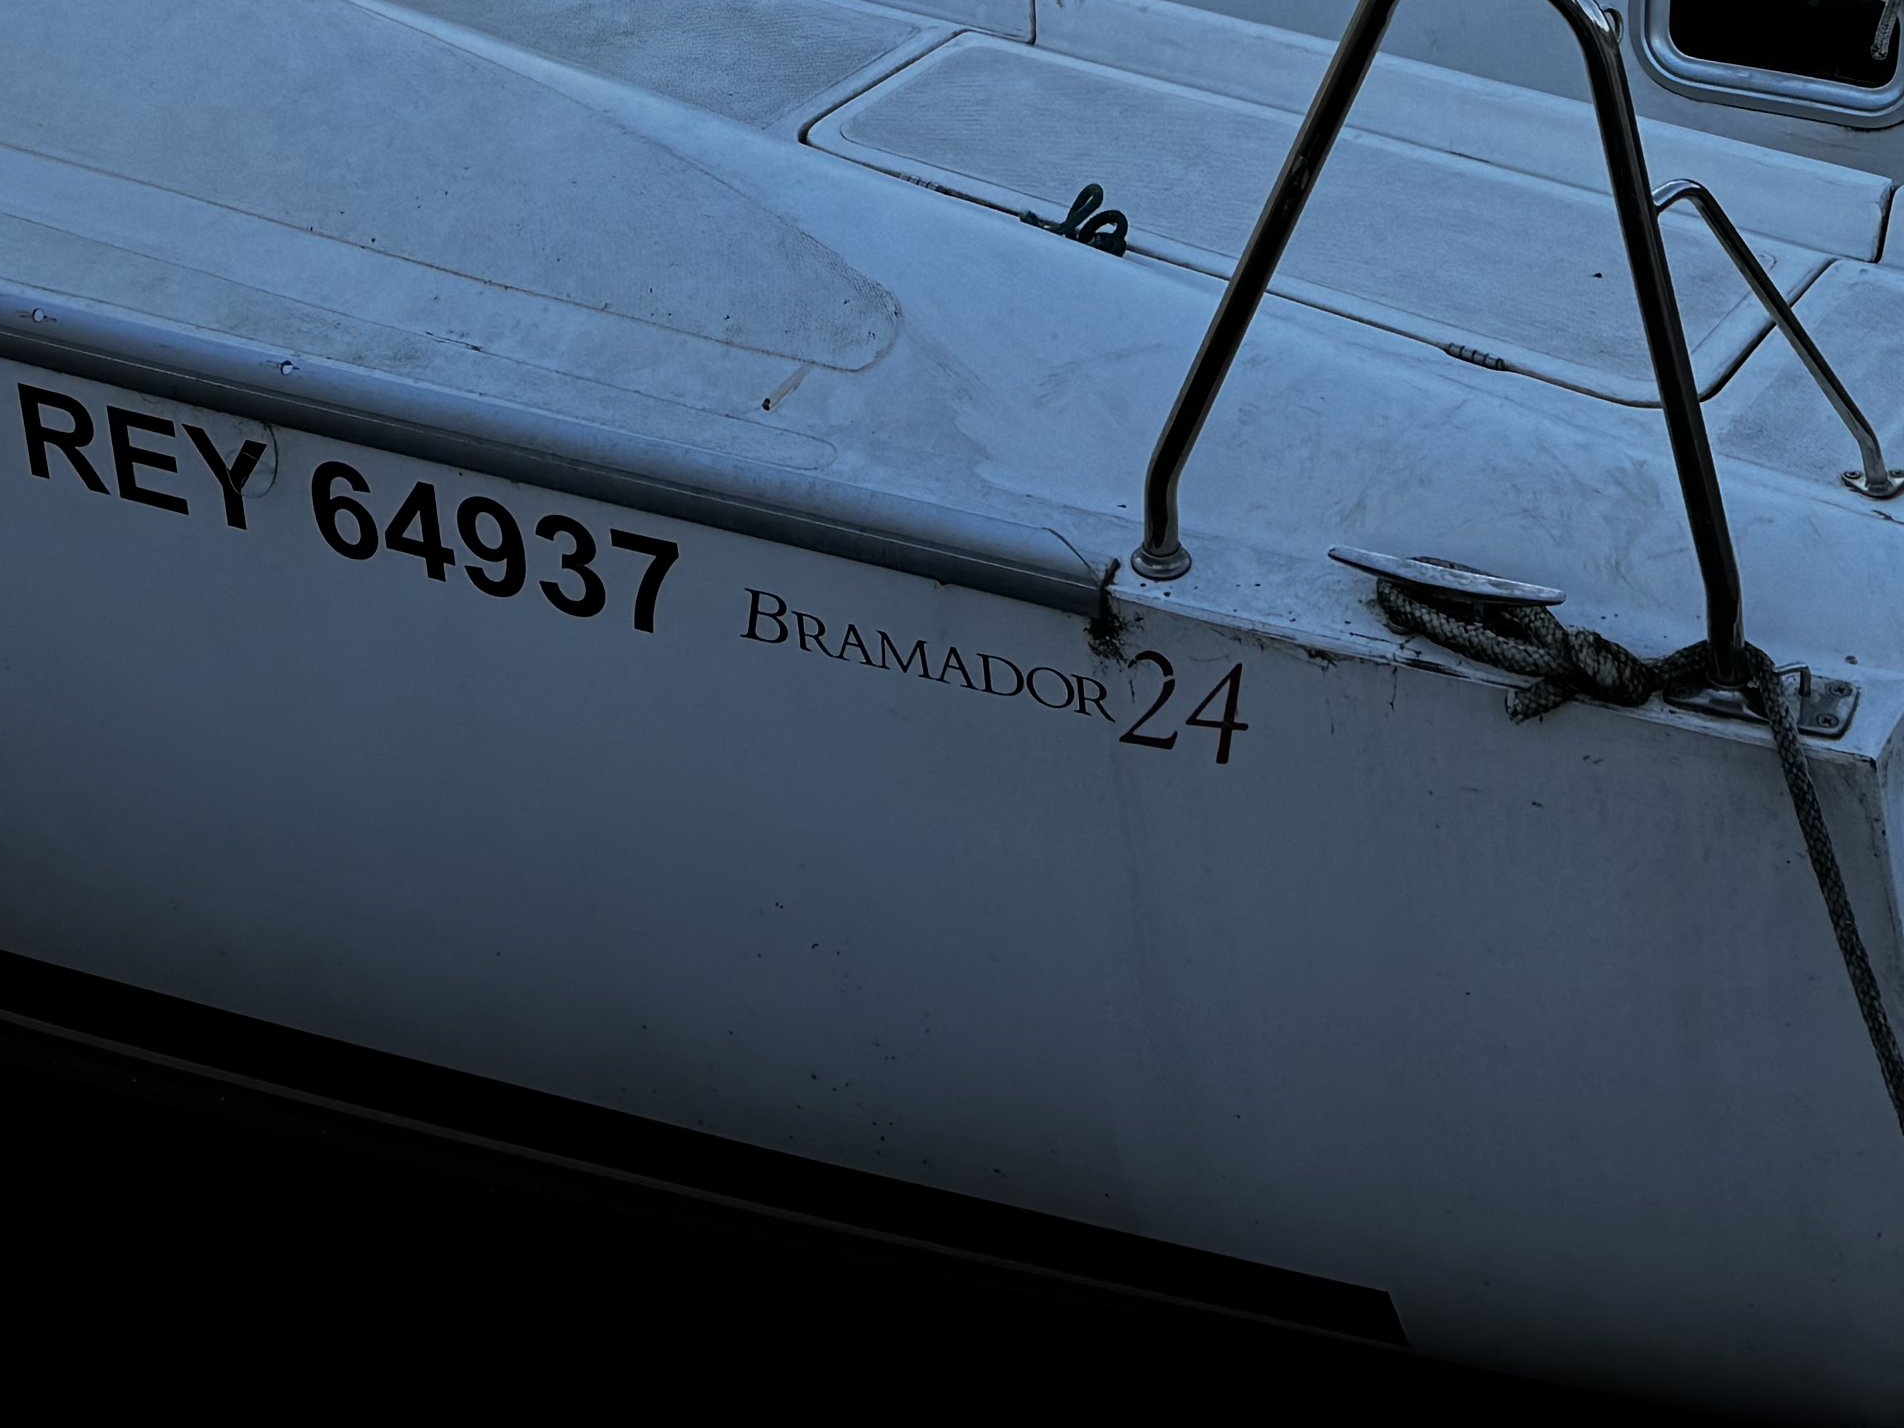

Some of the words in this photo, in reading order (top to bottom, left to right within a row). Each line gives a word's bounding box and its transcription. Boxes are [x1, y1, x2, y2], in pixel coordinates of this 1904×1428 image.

[17, 382, 268, 531] REY
[310, 460, 680, 635] 64937
[739, 587, 1117, 724] BRAMADOR
[1118, 649, 1250, 766] 24
